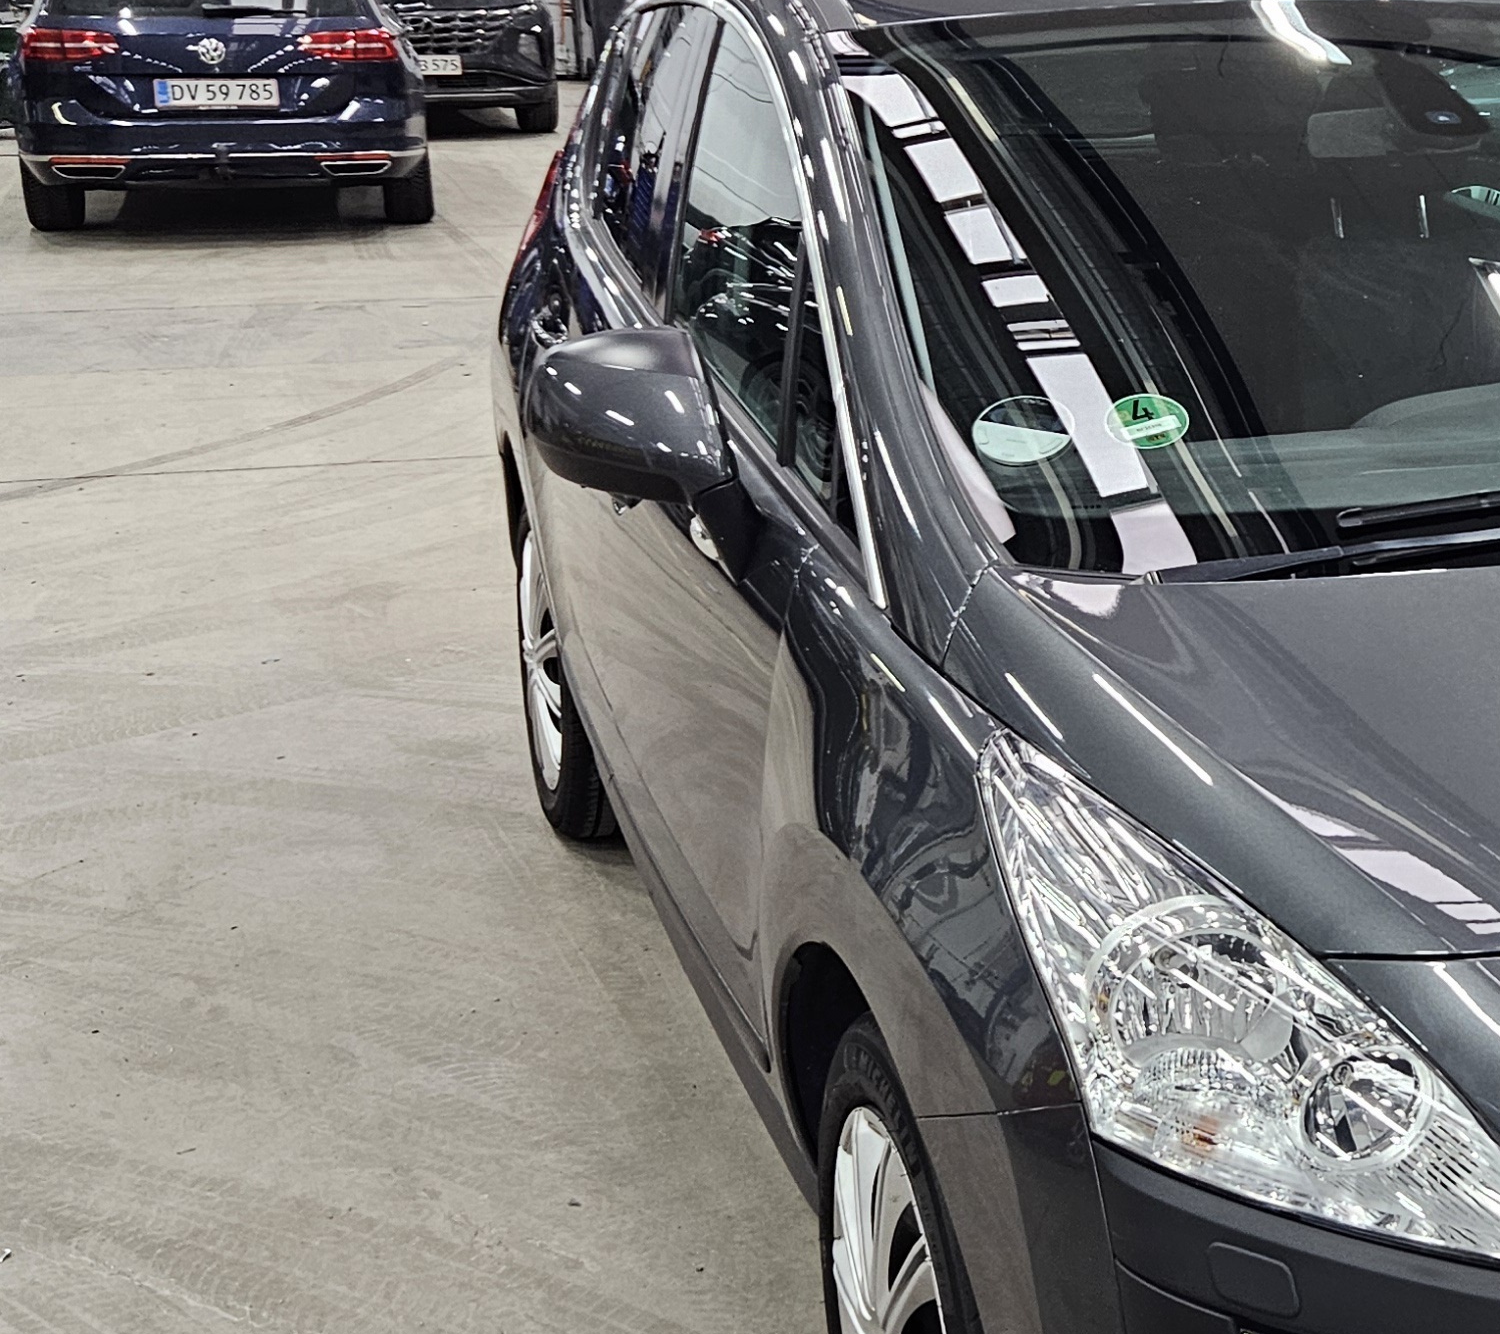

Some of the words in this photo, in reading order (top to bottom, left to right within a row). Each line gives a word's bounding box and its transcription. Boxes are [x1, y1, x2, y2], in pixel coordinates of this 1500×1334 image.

[432, 59, 459, 71] 575
[170, 83, 199, 101] DV
[205, 83, 230, 101] 59
[235, 82, 273, 101] 785
[1131, 399, 1155, 421] 4
[857, 1048, 923, 1178] MICHELIN
